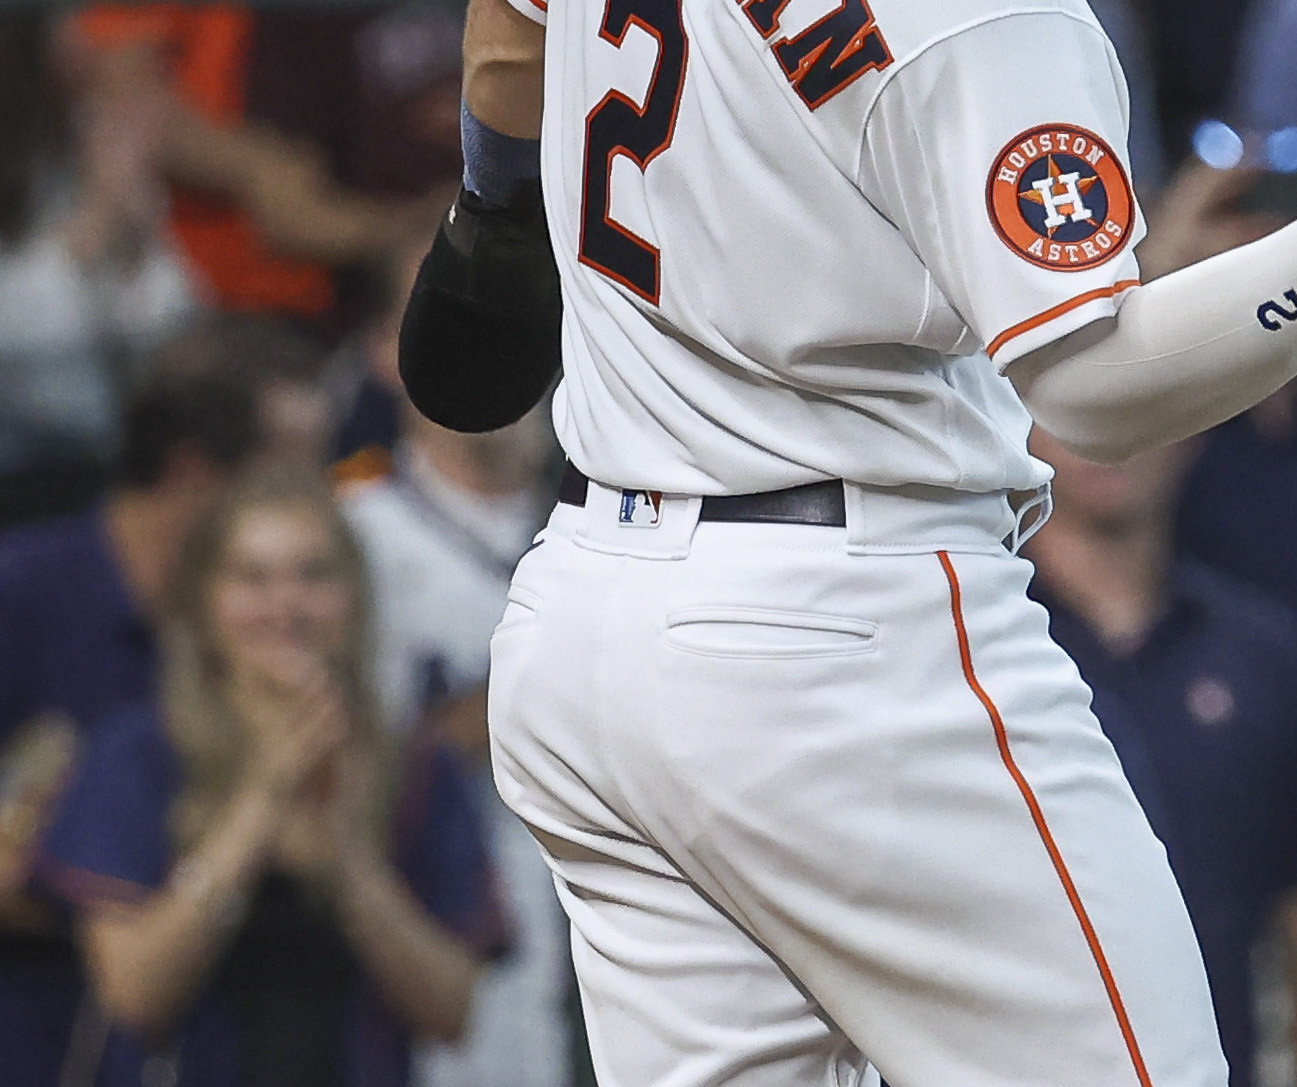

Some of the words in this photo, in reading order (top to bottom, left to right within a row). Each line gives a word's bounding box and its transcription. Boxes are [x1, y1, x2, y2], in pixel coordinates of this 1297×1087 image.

[997, 133, 1105, 185] HOUSTON
[1032, 171, 1093, 229] H
[1027, 219, 1123, 262] ASTROS
